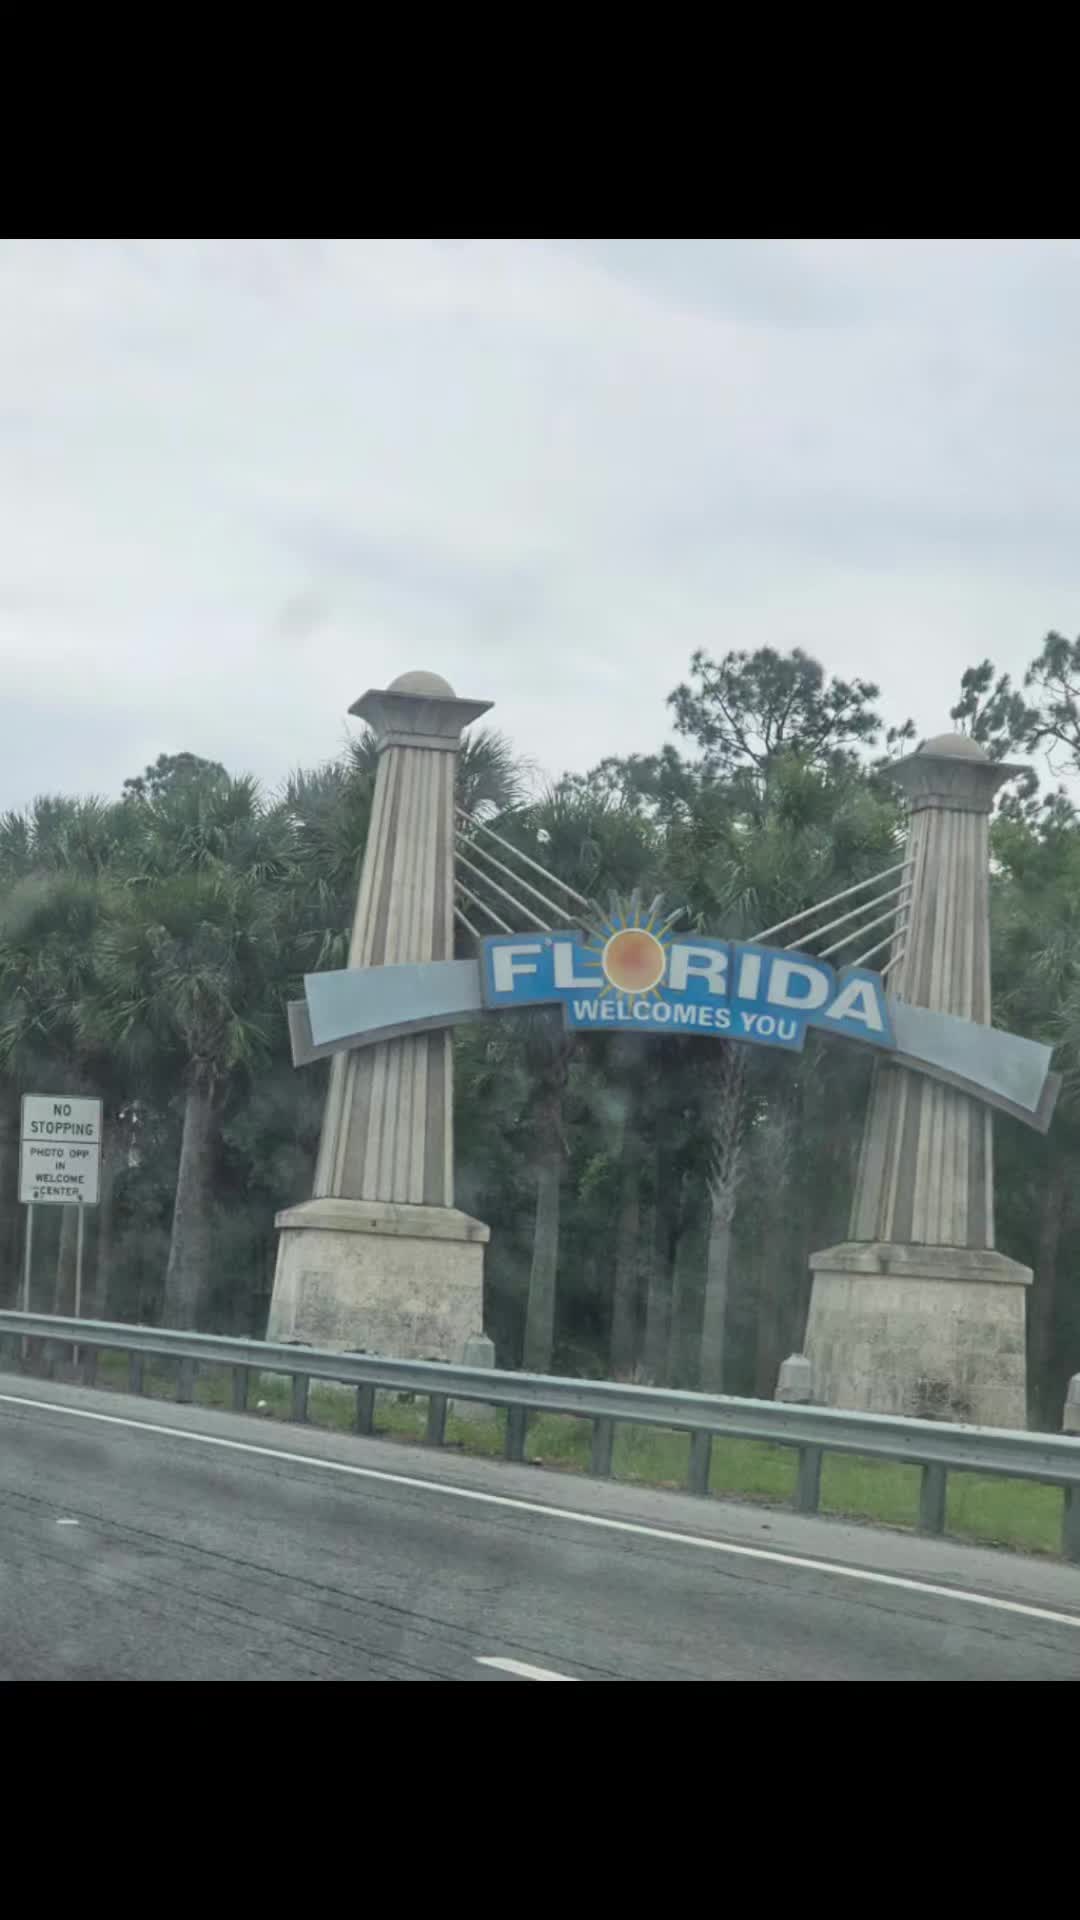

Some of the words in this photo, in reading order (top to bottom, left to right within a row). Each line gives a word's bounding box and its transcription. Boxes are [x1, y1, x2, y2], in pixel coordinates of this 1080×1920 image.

[491, 928, 884, 1032] FLORIDA
[573, 999, 731, 1028] WELCOMES
[739, 1013, 797, 1041] YOU
[53, 1103, 72, 1116] NO
[31, 1121, 94, 1136] STOPPING
[30, 1147, 64, 1158] PHOTO
[69, 1149, 89, 1158] OPP
[55, 1161, 66, 1171] IN
[35, 1173, 85, 1184] WELCOME
[39, 1186, 80, 1196] CENTER
